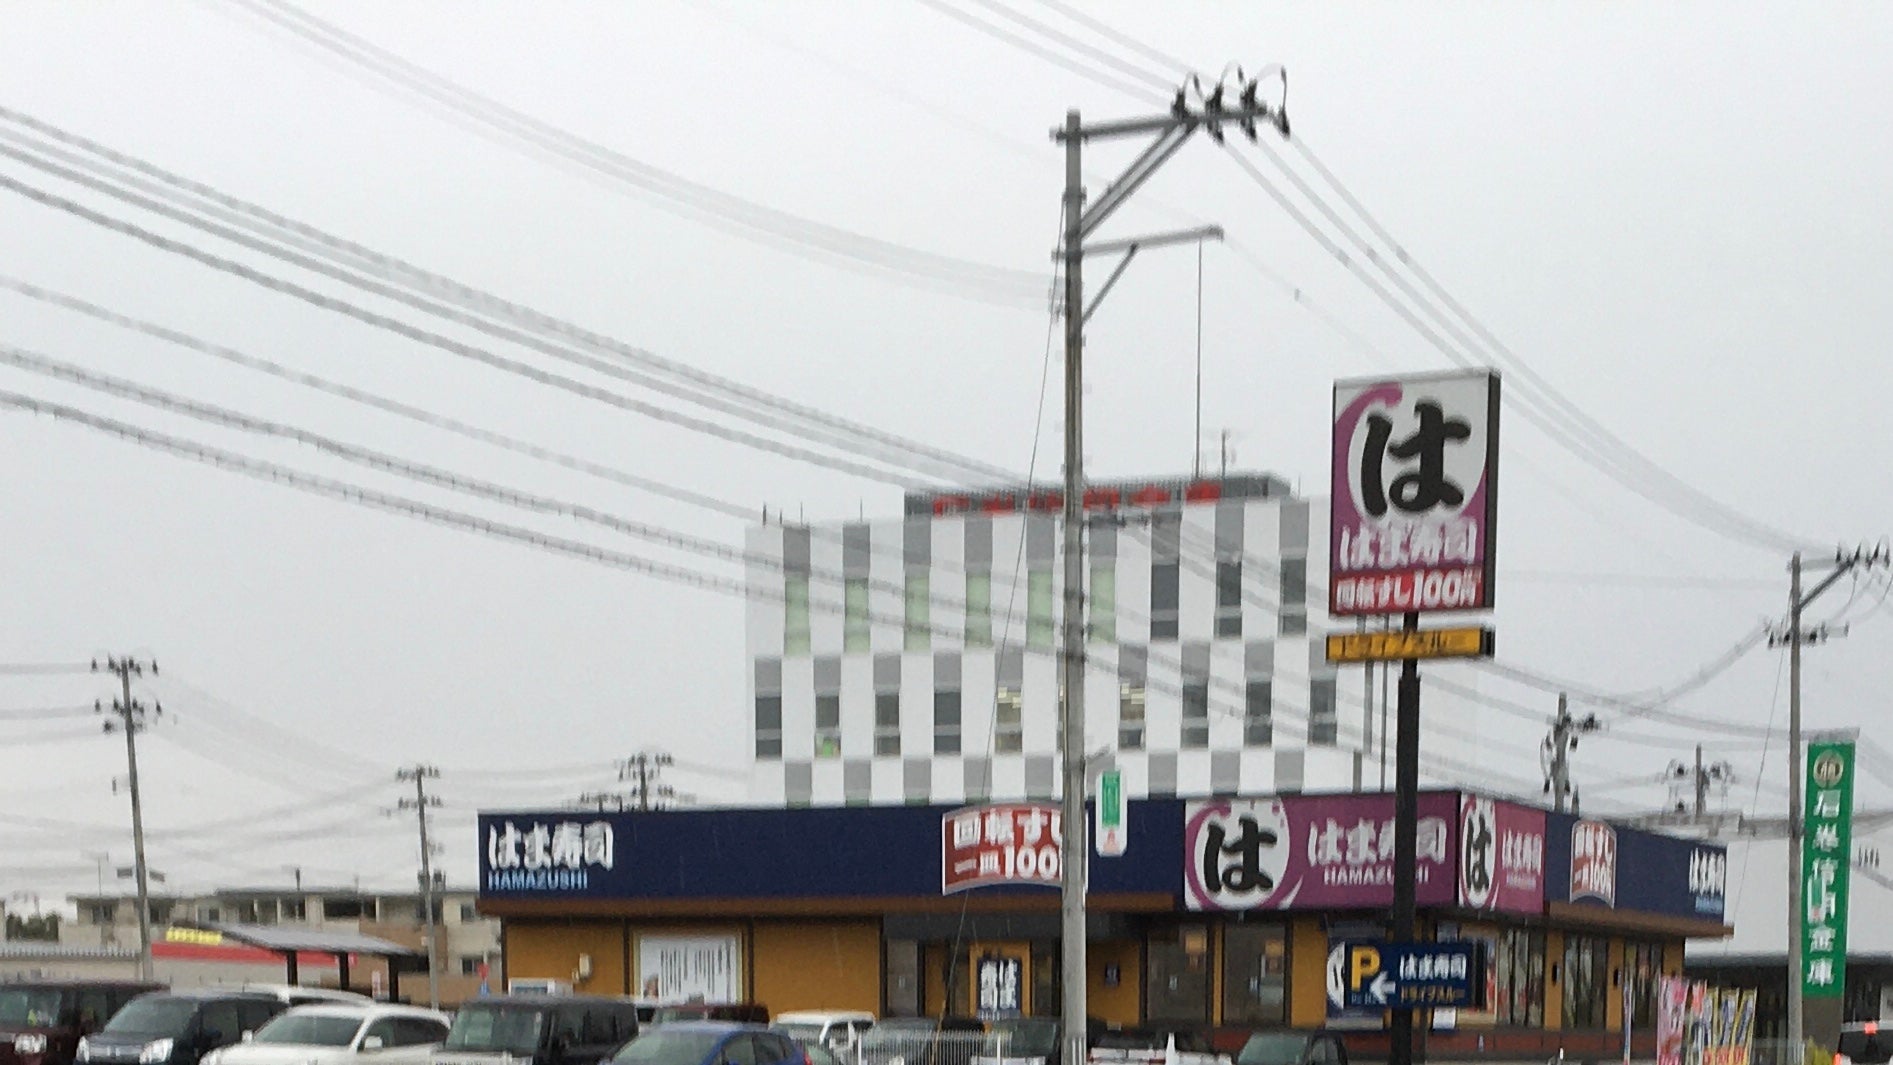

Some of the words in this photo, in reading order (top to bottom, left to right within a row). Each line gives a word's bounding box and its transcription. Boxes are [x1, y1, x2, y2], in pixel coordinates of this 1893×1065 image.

[1361, 397, 1472, 518] は
[488, 820, 613, 871] はま寿司
[954, 845, 1063, 881] 一皿100
[1204, 814, 1277, 892] は
[1466, 813, 1492, 894] は
[488, 869, 588, 890] HAMAZUSHI
[1324, 865, 1430, 886] HAMAZUHI
[1351, 945, 1381, 992] P
